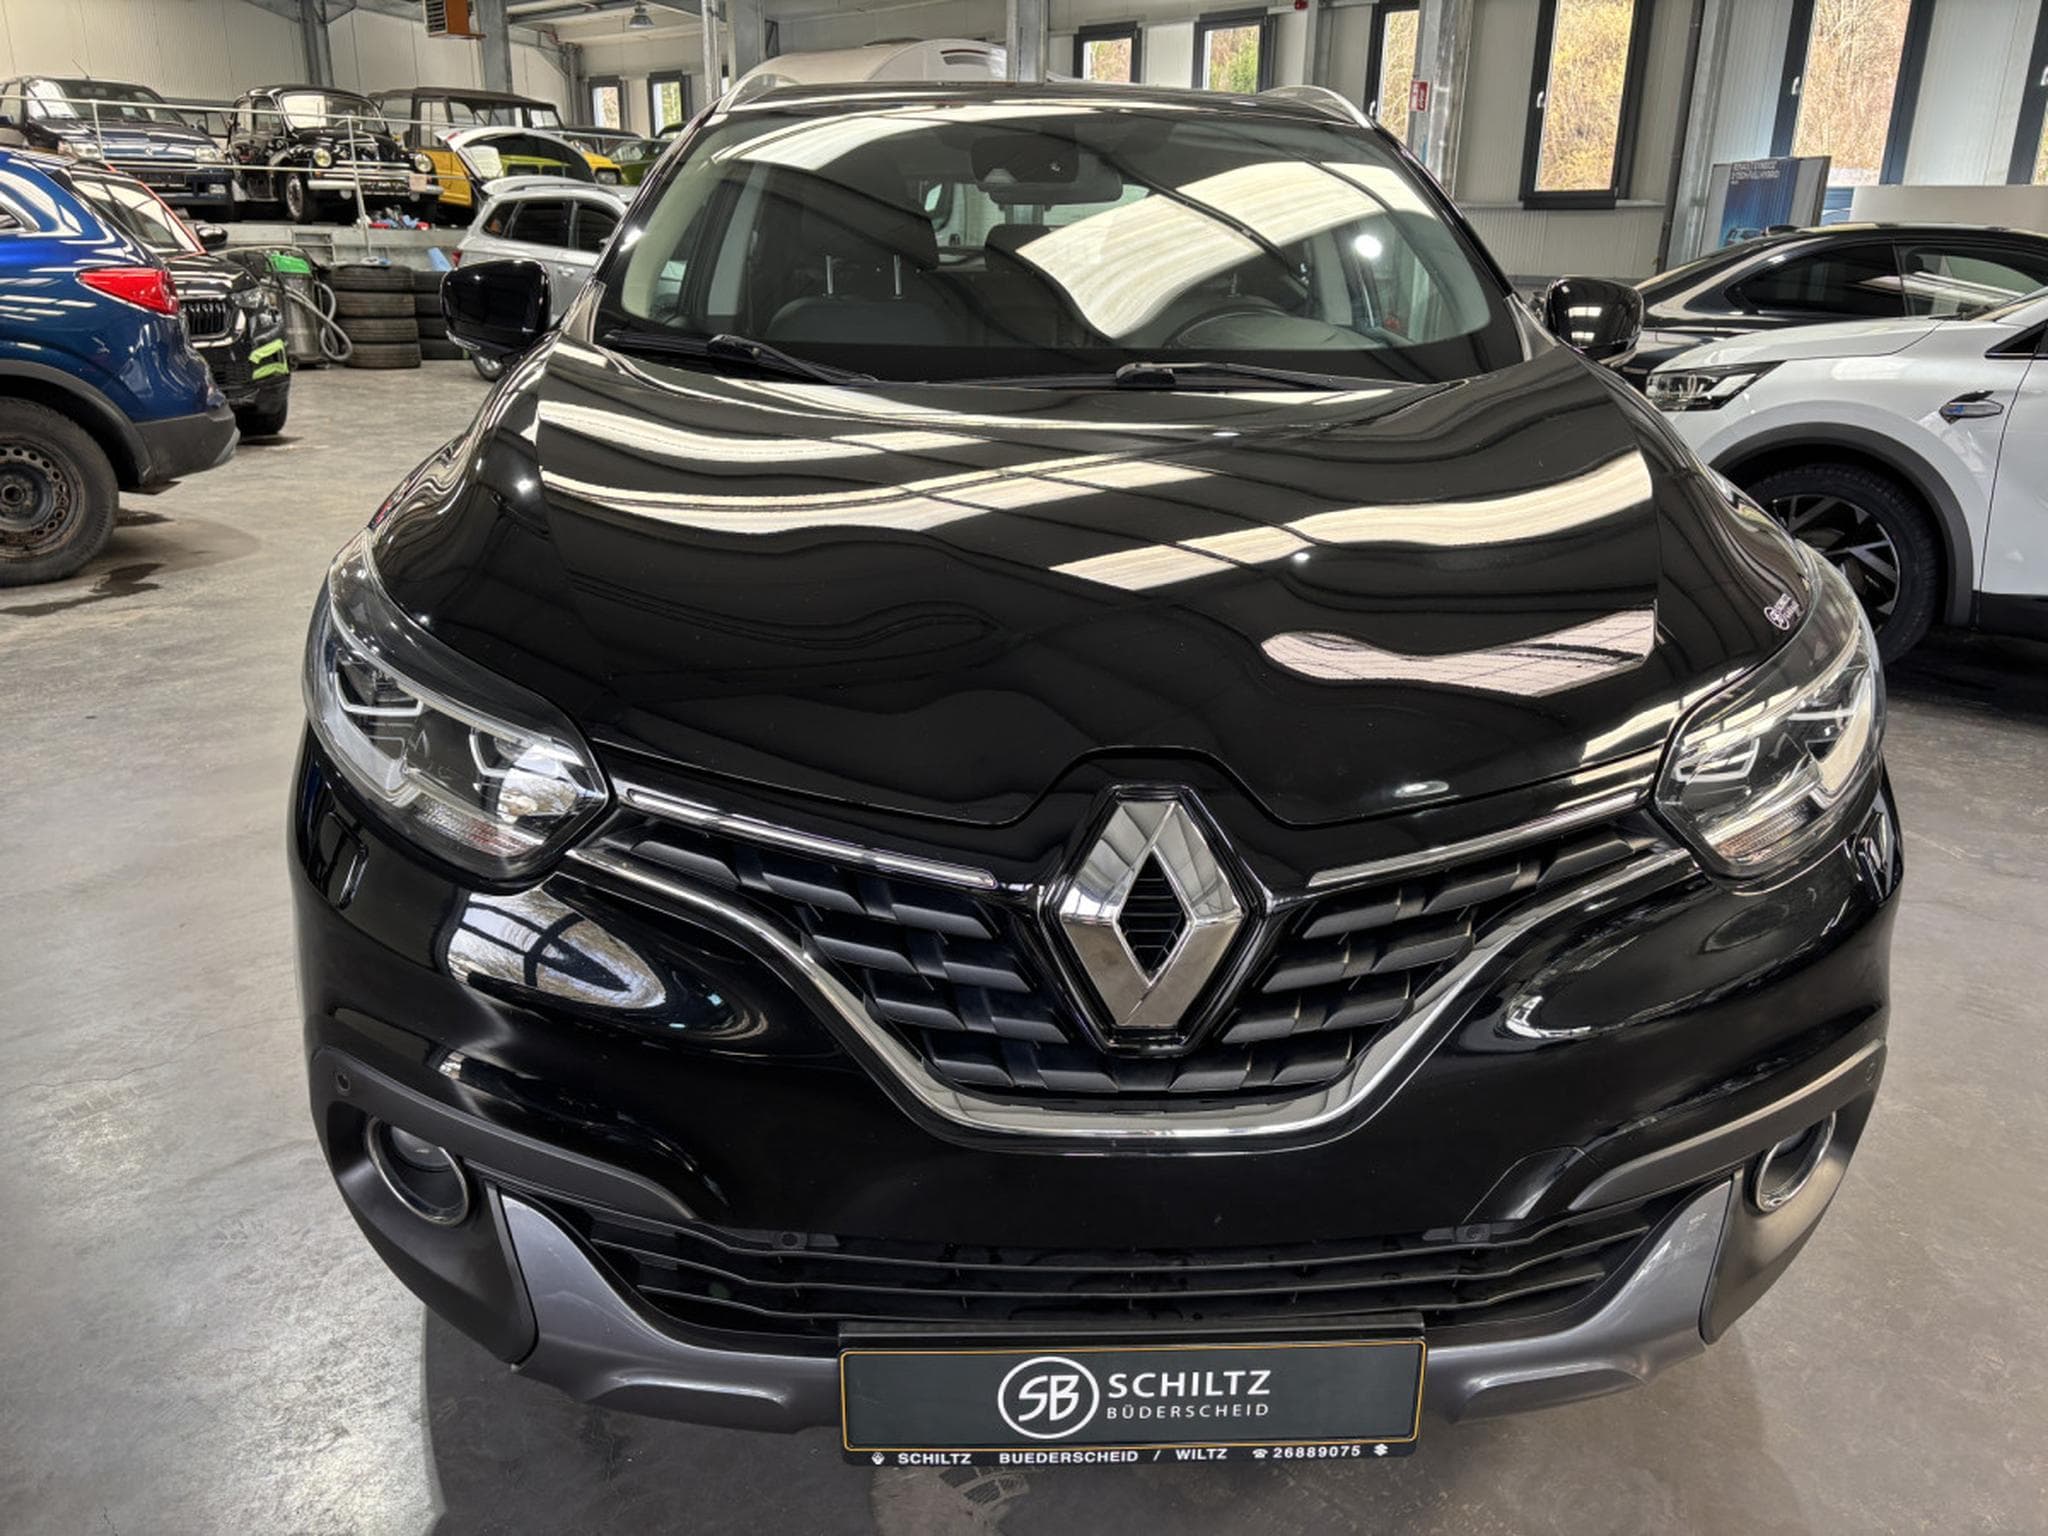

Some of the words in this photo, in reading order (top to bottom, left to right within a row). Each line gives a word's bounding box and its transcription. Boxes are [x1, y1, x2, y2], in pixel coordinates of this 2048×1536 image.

[1107, 1369, 1272, 1399] SCHILTZ
[1017, 1374, 1080, 1422] SB
[1106, 1402, 1270, 1420] BÜDERSCHEID
[897, 1452, 972, 1465] SCHILTZ
[999, 1450, 1139, 1464] BUEDERSCHEID
[1175, 1448, 1229, 1461] WILTZ
[1272, 1445, 1362, 1459] 26889075
